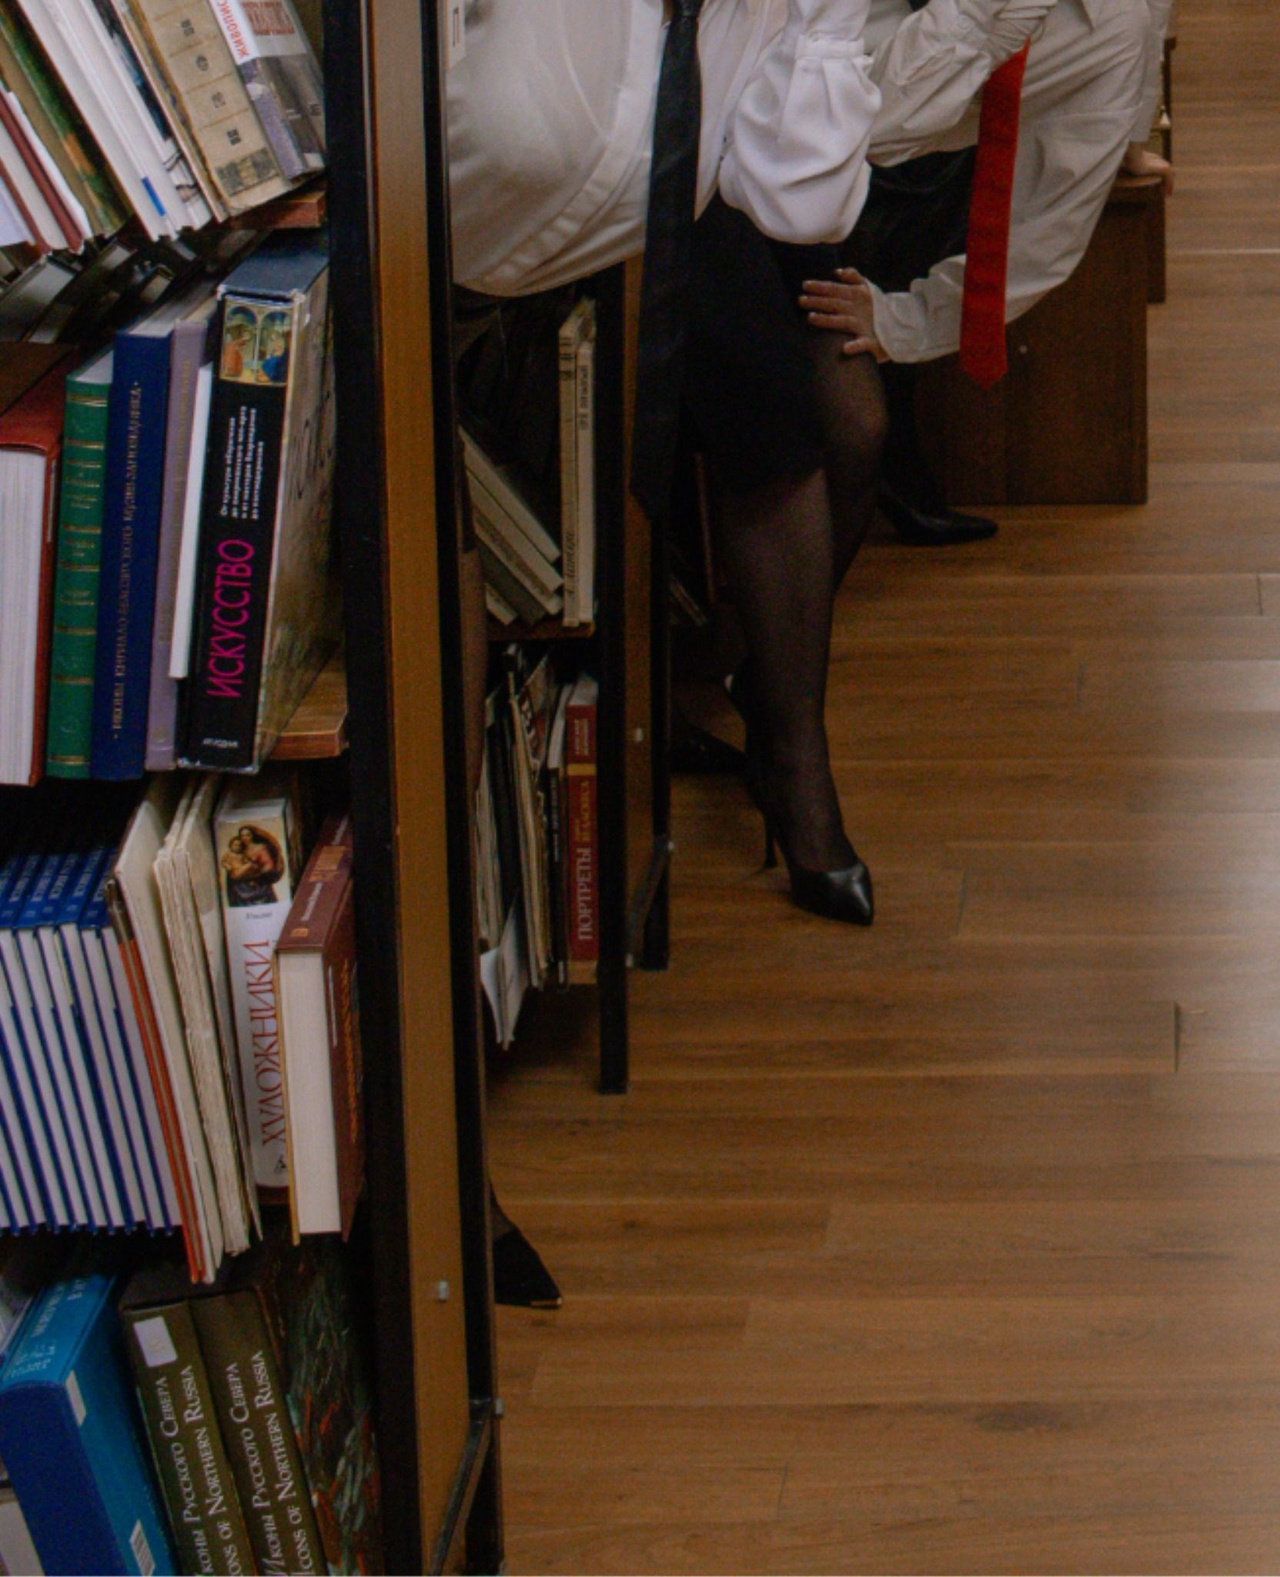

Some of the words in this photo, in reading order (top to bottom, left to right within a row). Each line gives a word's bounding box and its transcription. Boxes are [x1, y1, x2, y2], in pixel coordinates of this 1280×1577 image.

[205, 537, 255, 698] ИСКУССТВО
[575, 847, 592, 939] ПОРТРЕТЫ
[244, 940, 288, 1147] ХУДОЖНИКИ
[190, 1527, 215, 1575] КОНЫ
